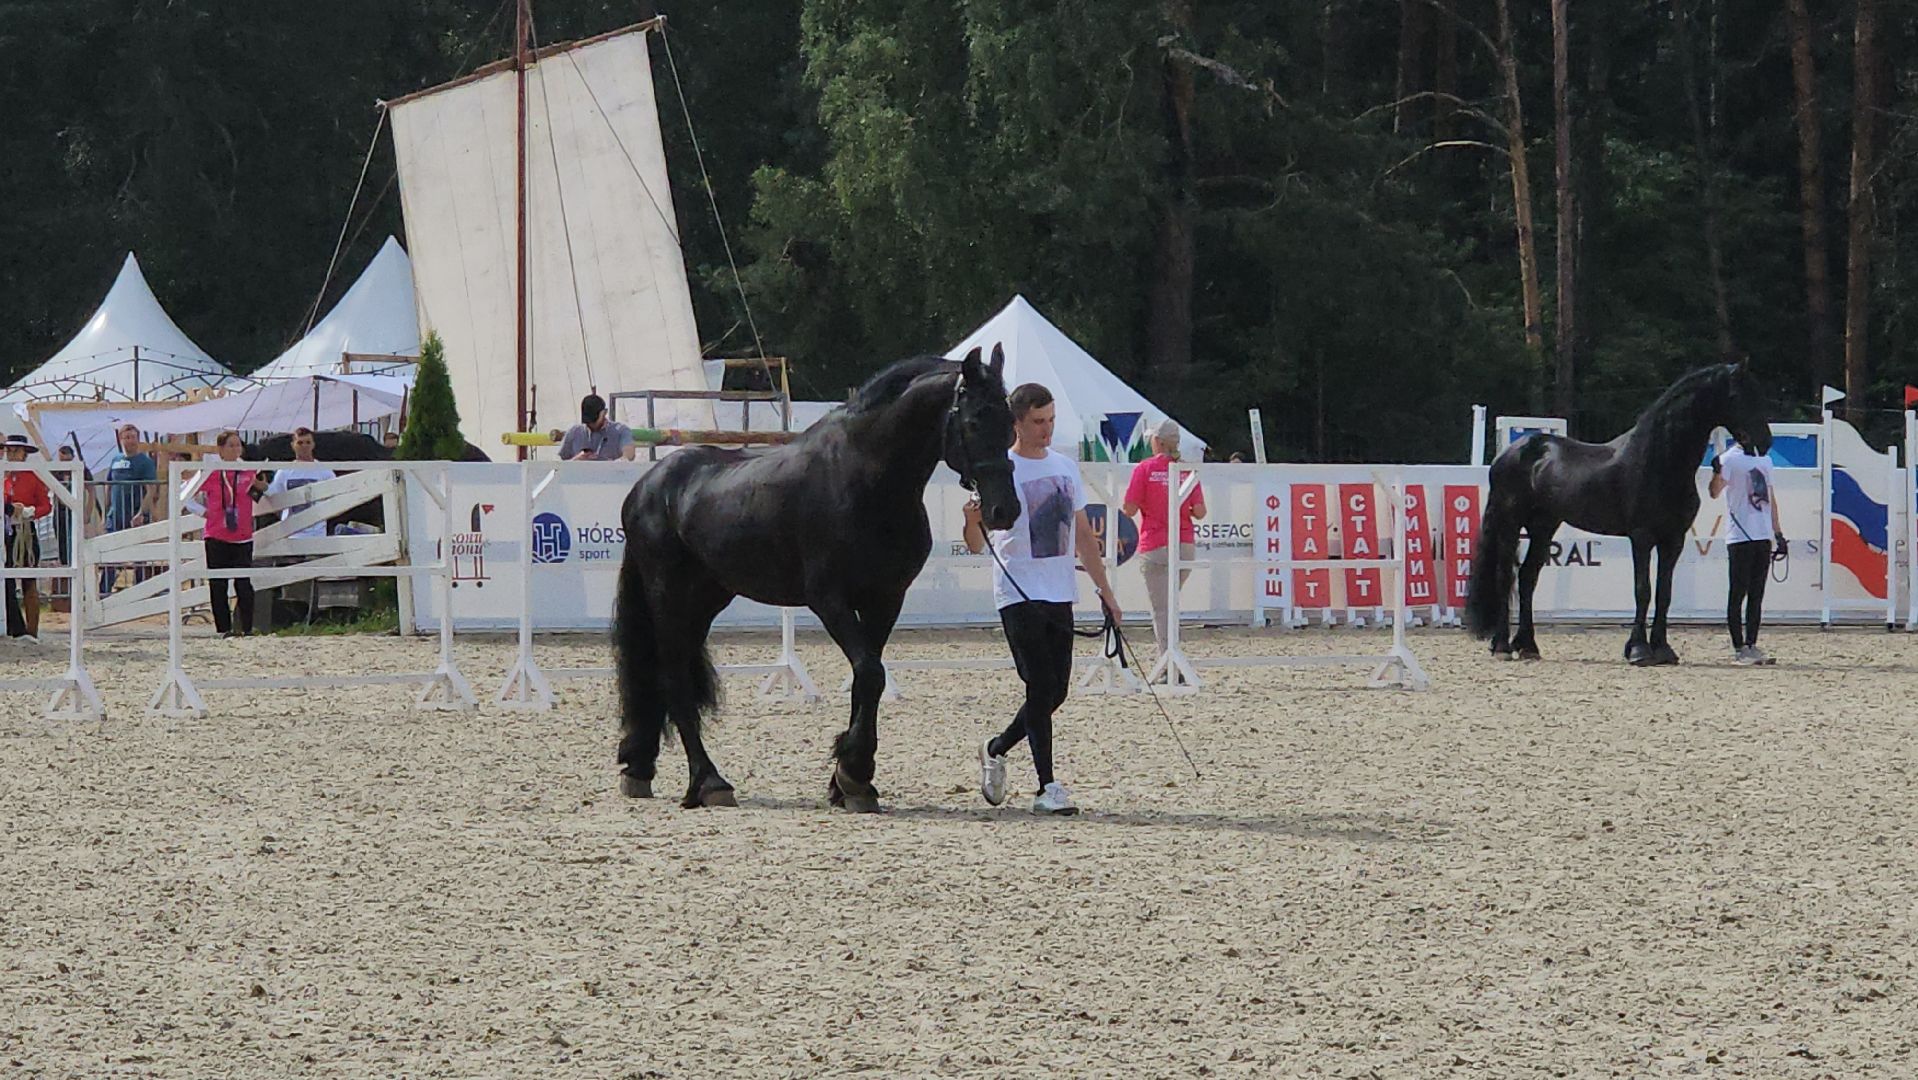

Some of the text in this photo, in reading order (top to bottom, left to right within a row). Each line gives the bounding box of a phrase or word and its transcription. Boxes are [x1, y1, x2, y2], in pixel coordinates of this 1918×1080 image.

[1193, 523, 1254, 538] RSEFAC
[1404, 493, 1430, 598] ФИНИШ
[579, 548, 610, 561] sport
